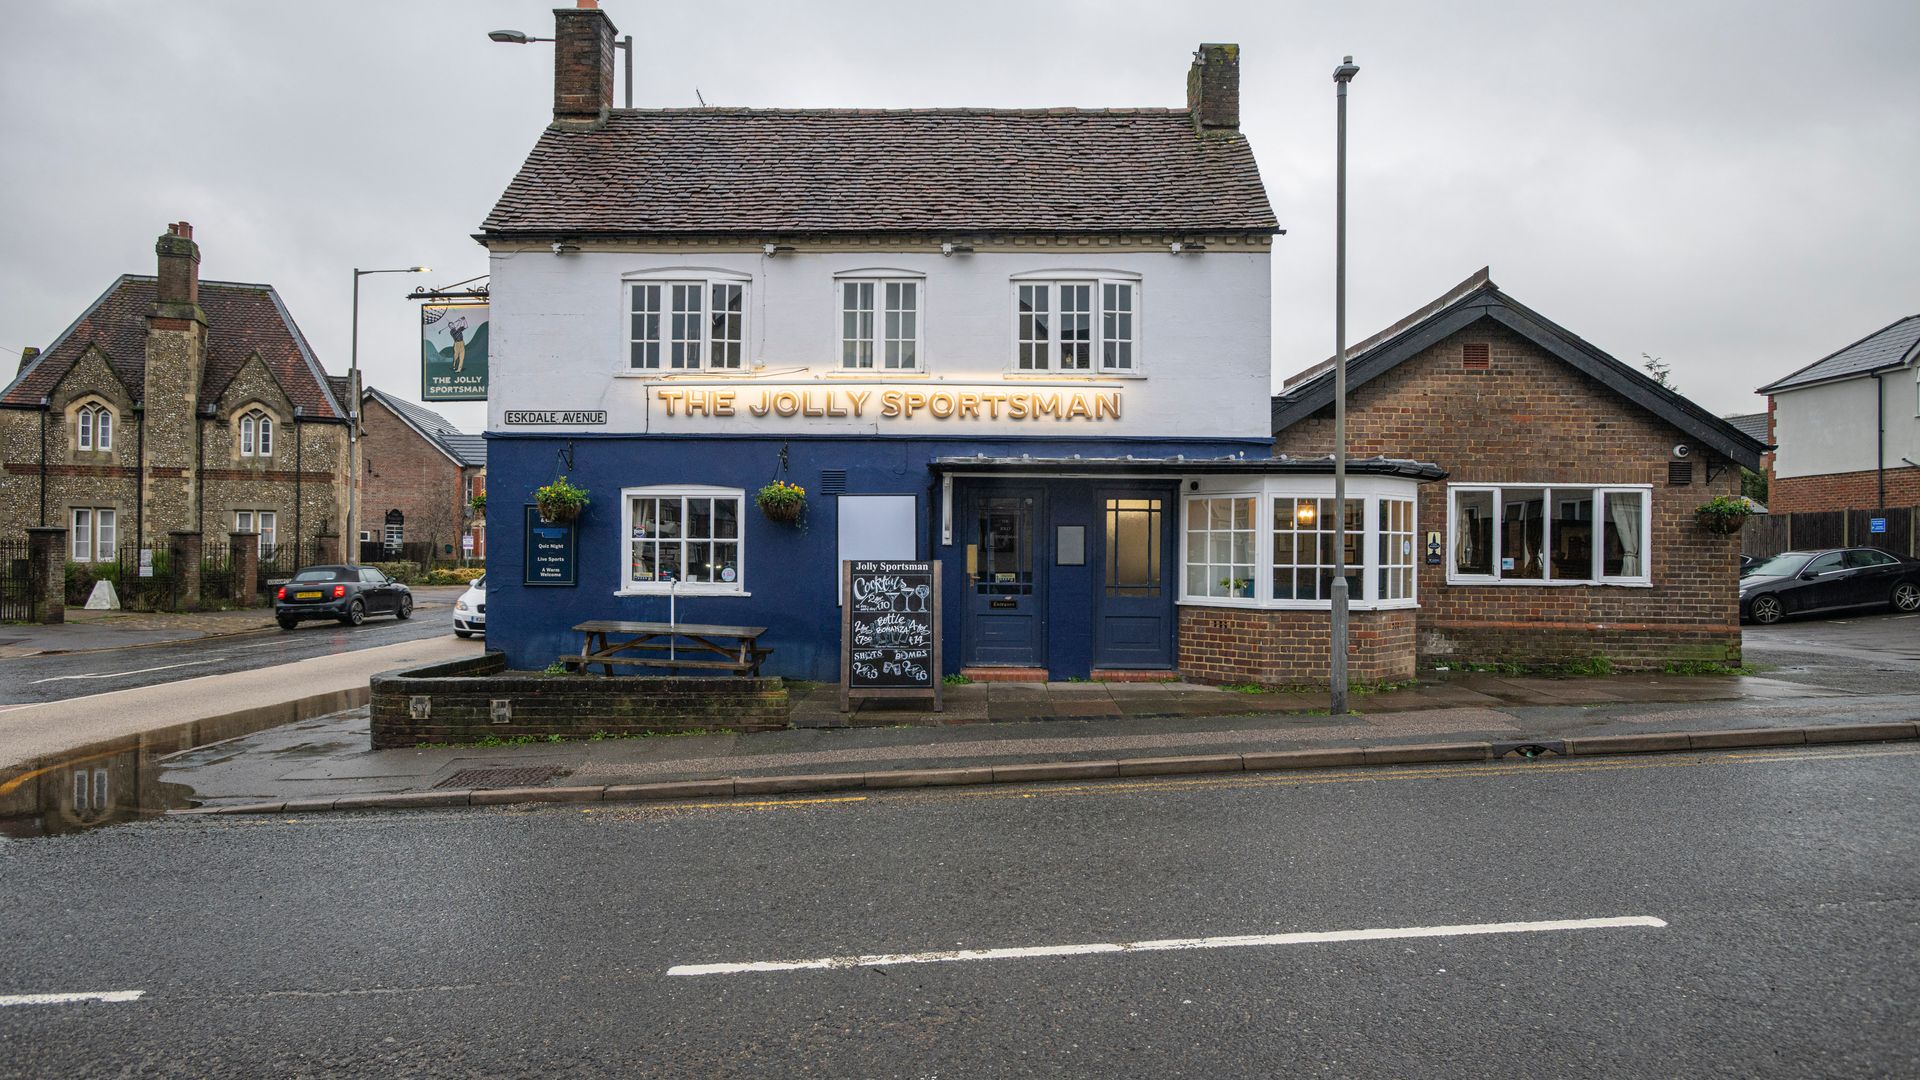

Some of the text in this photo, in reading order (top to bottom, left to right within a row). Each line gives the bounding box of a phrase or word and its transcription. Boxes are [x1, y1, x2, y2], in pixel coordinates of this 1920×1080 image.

[432, 375, 482, 384] THE JOLLY
[430, 385, 485, 394] SPORTSMAN
[658, 389, 1122, 420] THE JOLLY SPORTSMAN
[507, 412, 604, 423] ESKDALE AVENUE
[855, 562, 929, 573] Jolly Sportsman
[854, 575, 907, 600] Cocktails
[877, 613, 906, 626] Bottle
